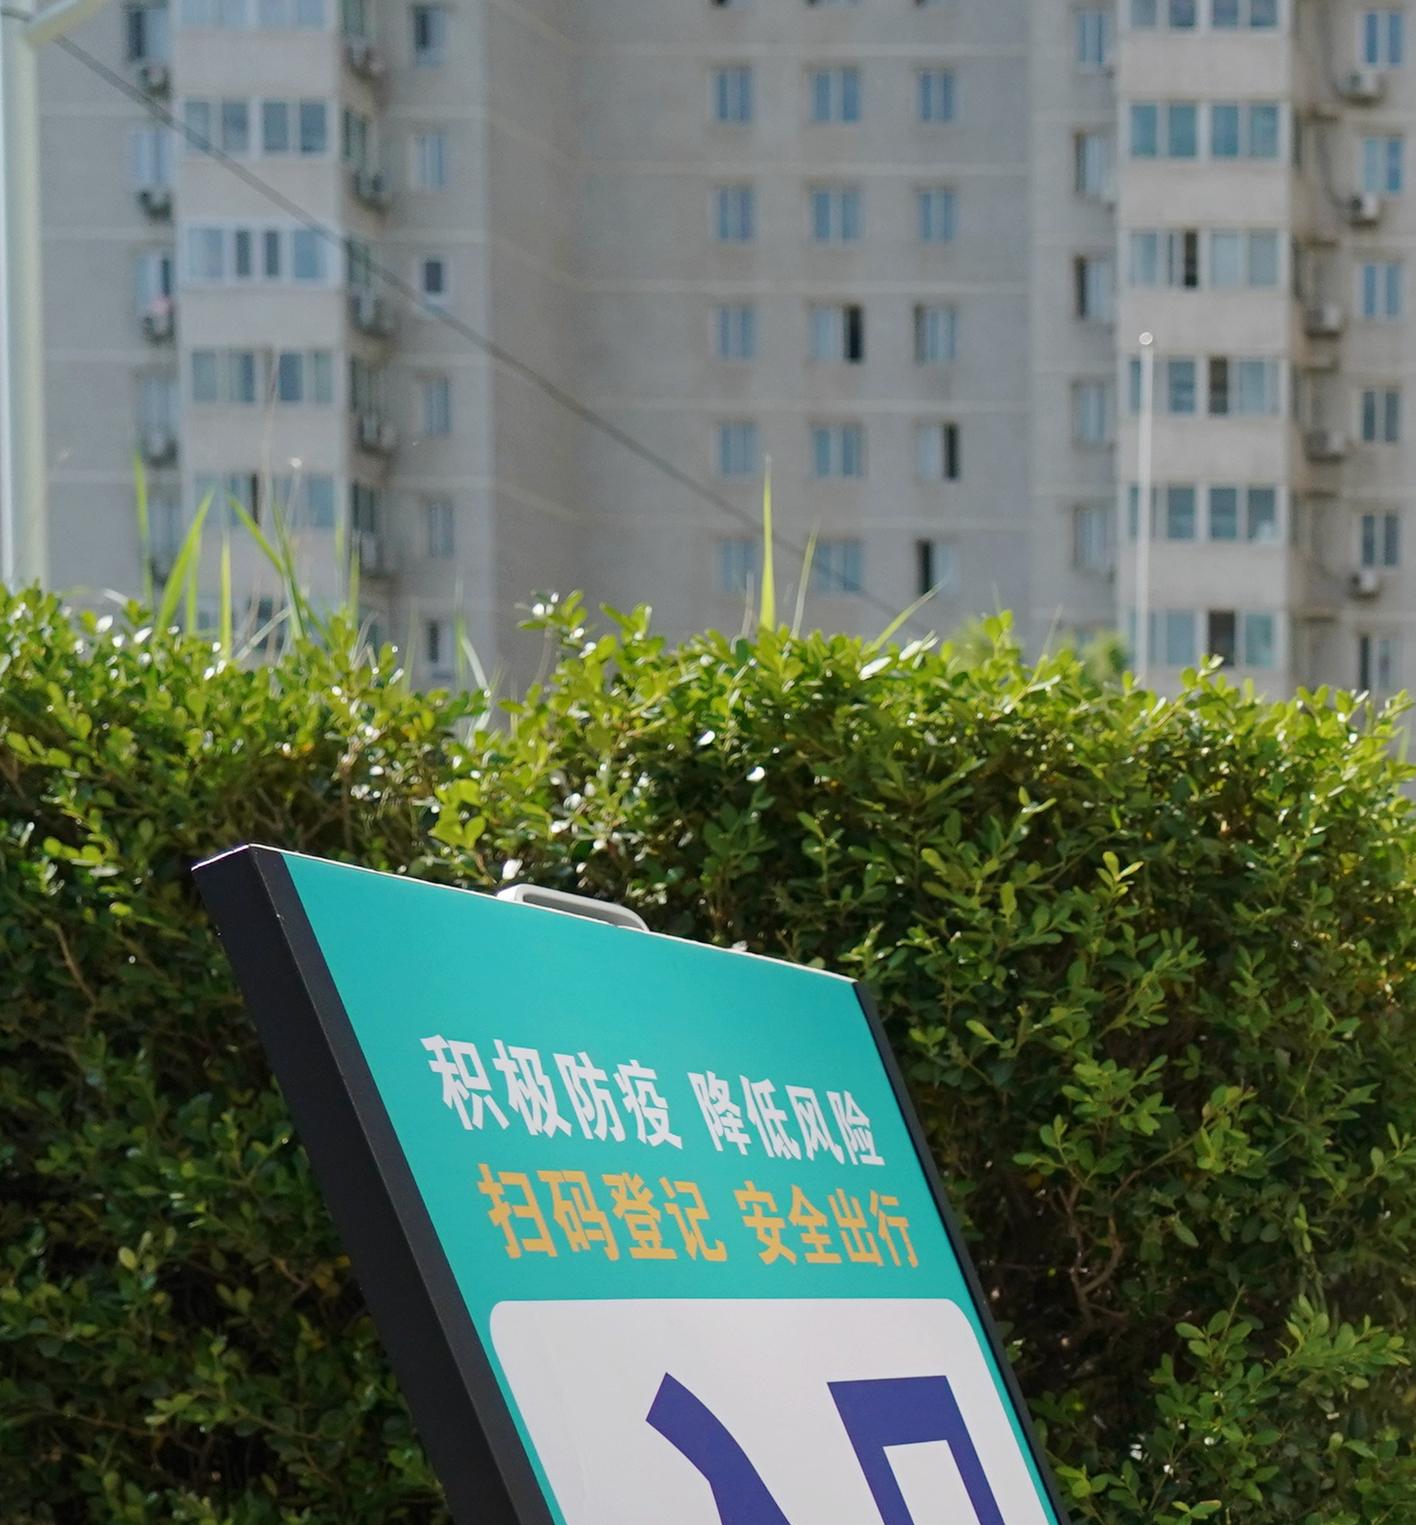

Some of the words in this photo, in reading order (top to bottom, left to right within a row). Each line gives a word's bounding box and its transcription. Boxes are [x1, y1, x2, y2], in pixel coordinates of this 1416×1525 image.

[419, 1033, 683, 1150] 积极防疫
[687, 1070, 886, 1167] 降低风险
[475, 1163, 728, 1262] 扫码登记
[734, 1180, 919, 1268] 安全出行
